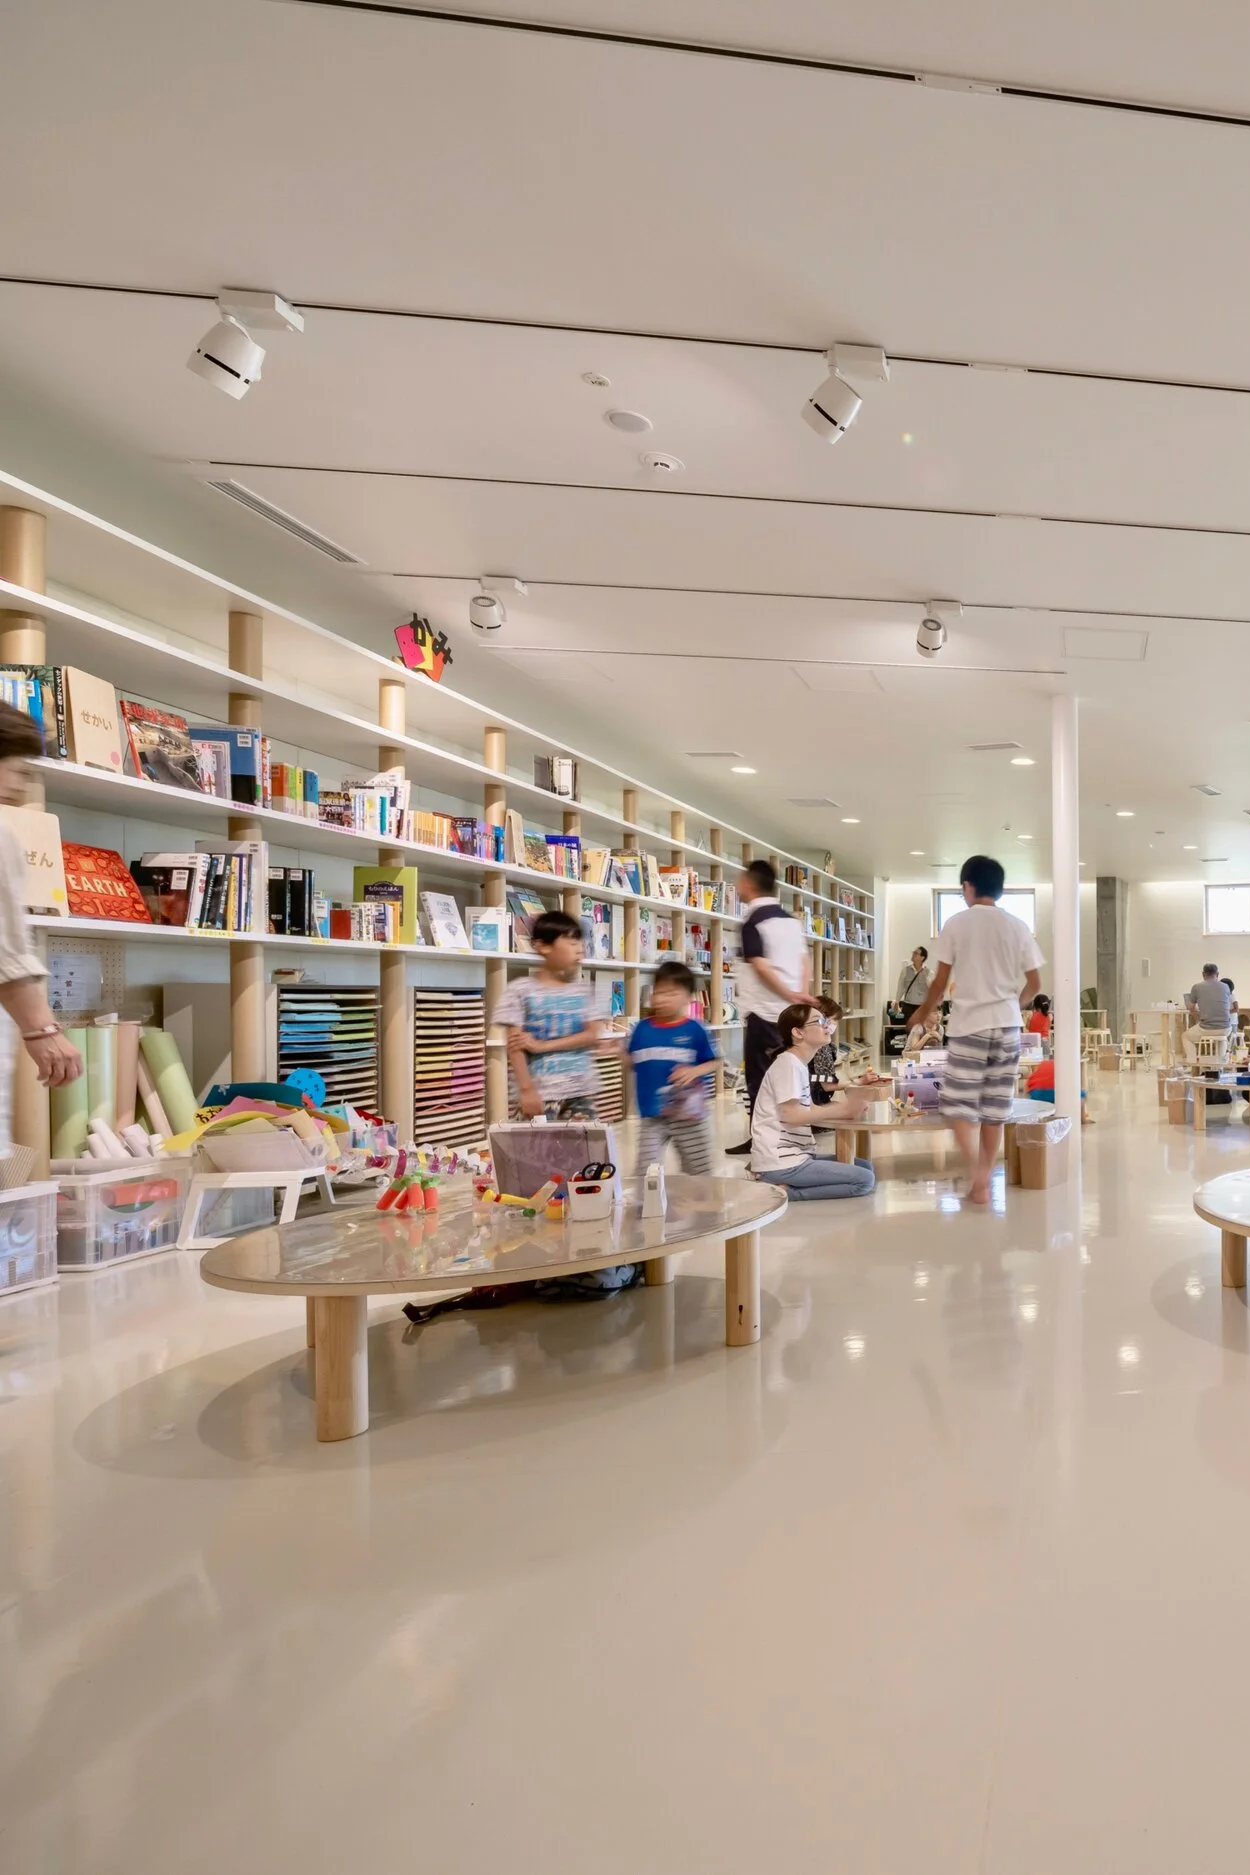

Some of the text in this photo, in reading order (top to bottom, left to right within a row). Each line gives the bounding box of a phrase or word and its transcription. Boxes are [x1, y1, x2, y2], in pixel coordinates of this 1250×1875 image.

[410, 612, 453, 664] かみ
[81, 709, 113, 731] せかい
[24, 850, 54, 868] ぜん
[65, 874, 128, 898] EARTH
